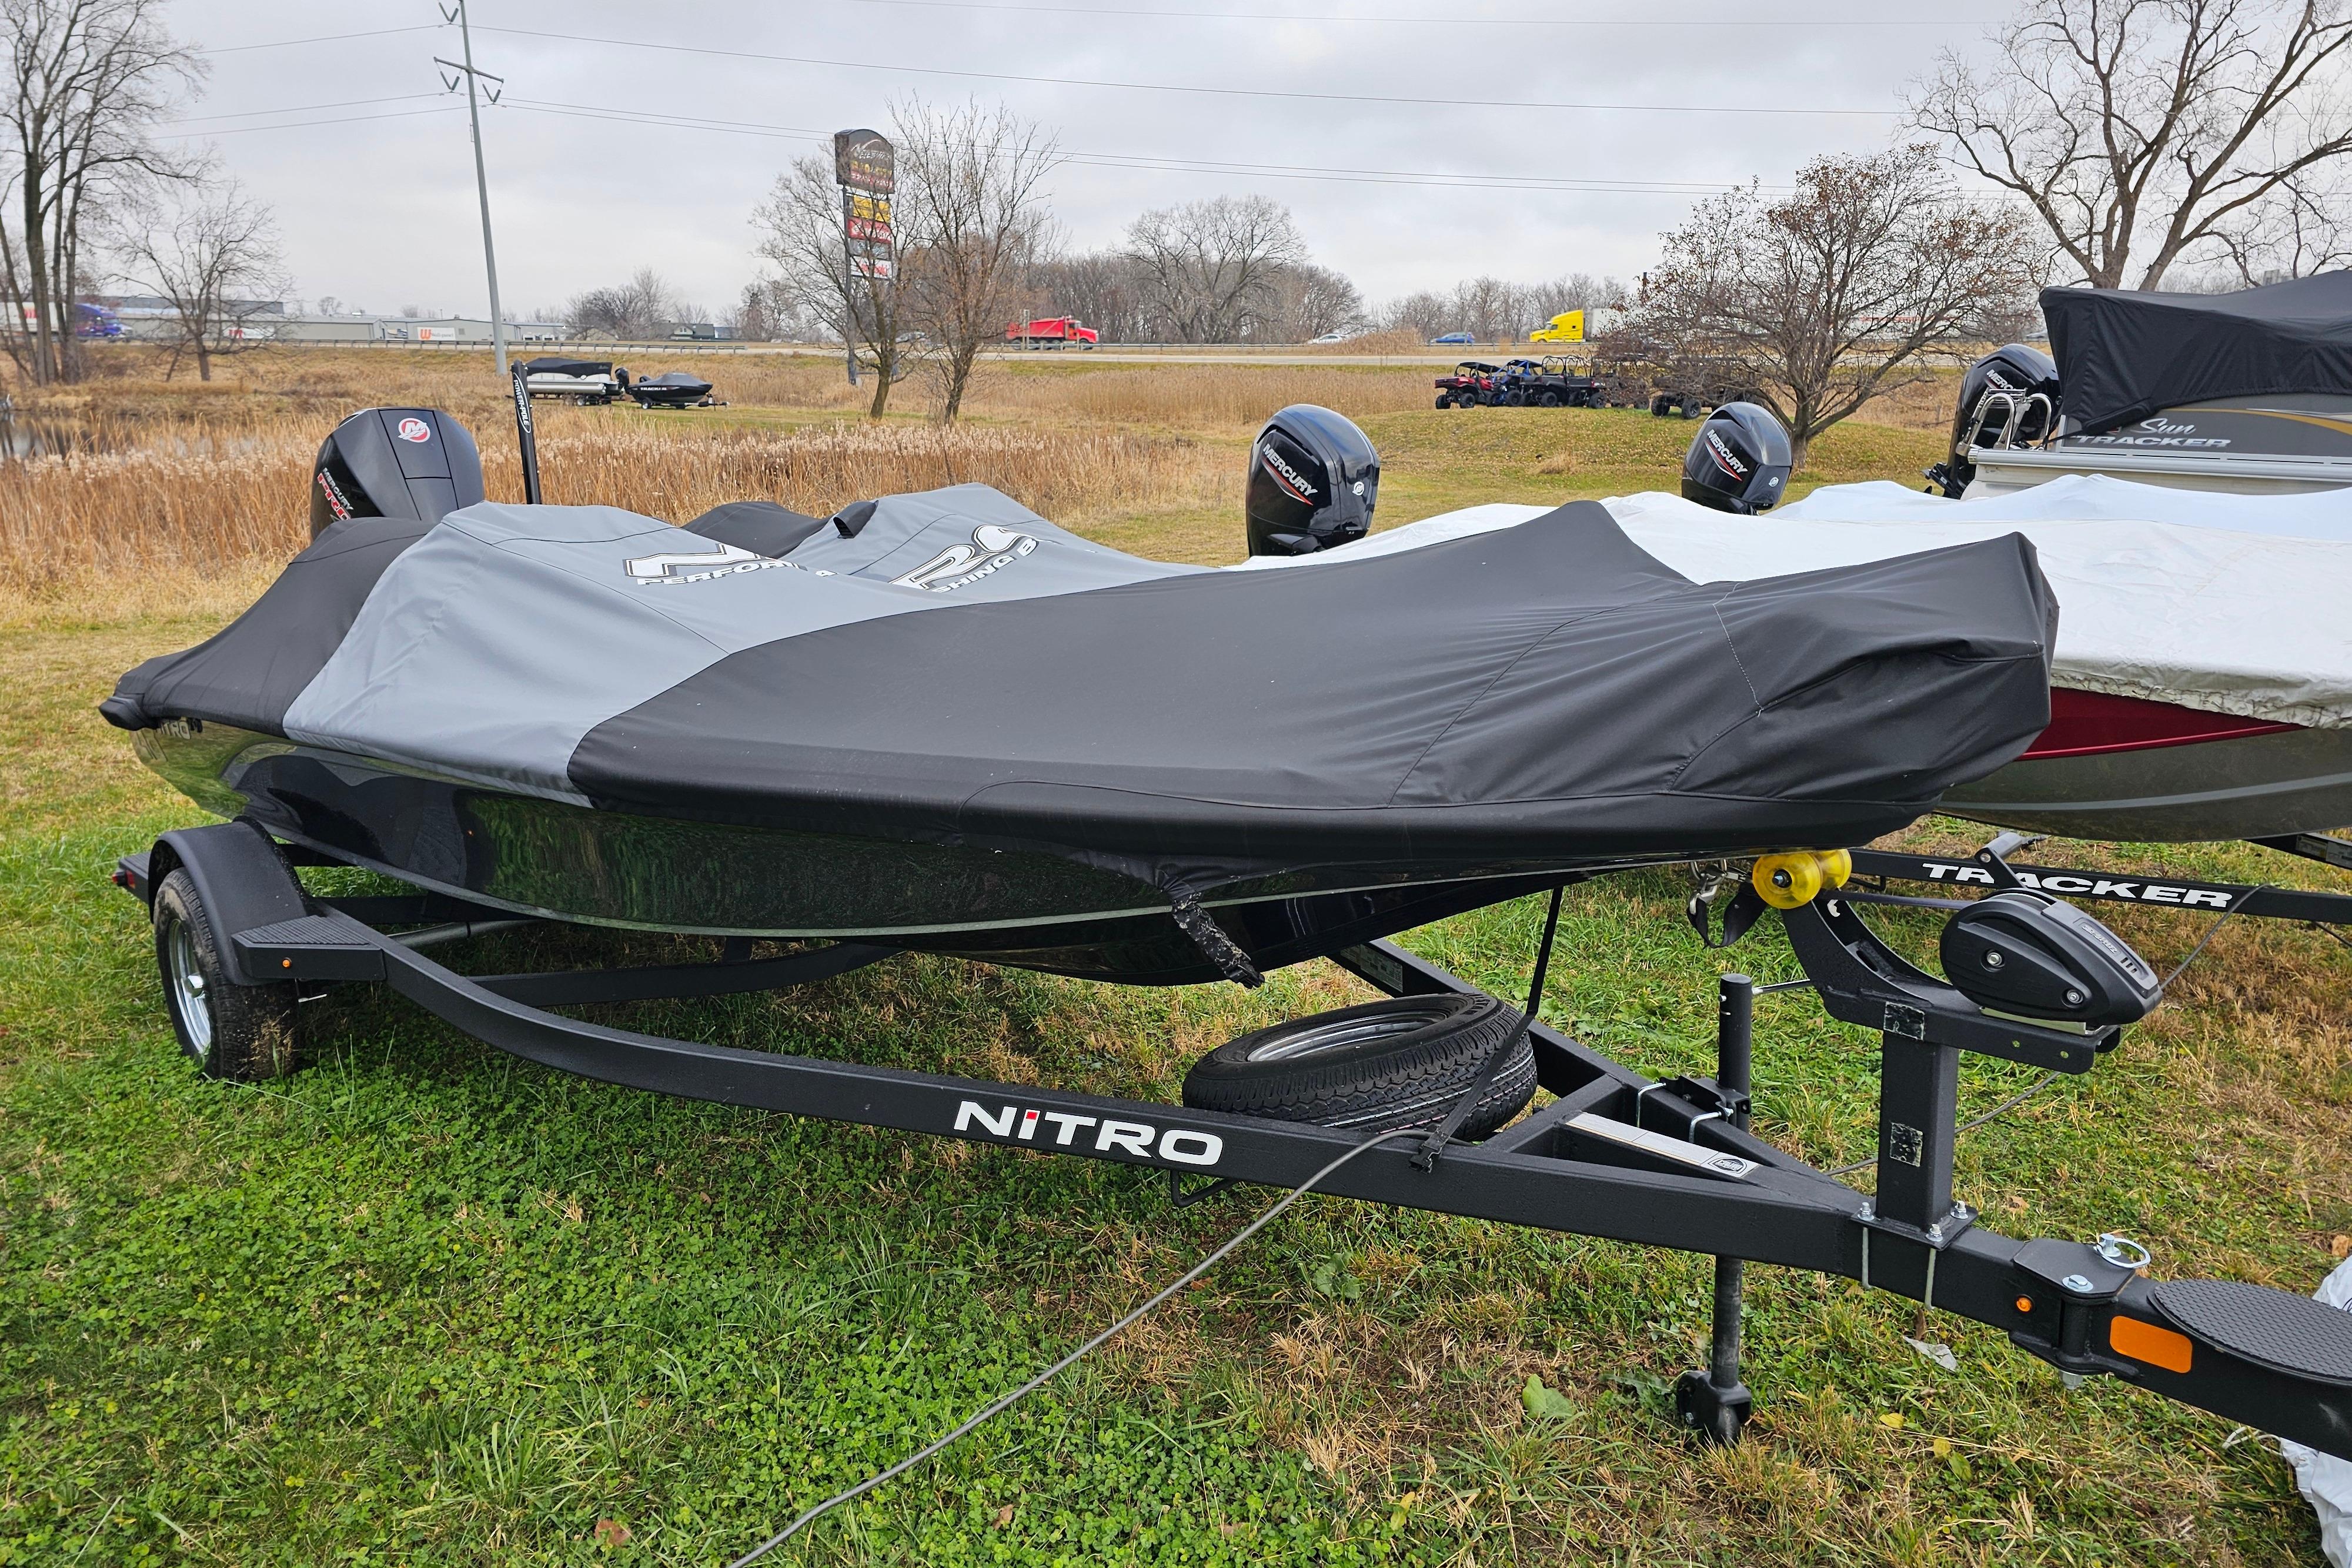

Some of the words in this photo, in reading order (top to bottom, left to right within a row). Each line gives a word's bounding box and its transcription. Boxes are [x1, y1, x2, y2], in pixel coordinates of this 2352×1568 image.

[1986, 369, 2016, 389] MERC
[2070, 435, 2231, 448] TRACKER
[2130, 418, 2196, 435] Sun
[1263, 443, 1318, 496] MERCURY
[1707, 429, 1748, 473] MERCURY
[322, 467, 354, 510] MERCURY
[1921, 862, 2233, 908] TRACKER
[953, 1100, 1224, 1166] NITRO
